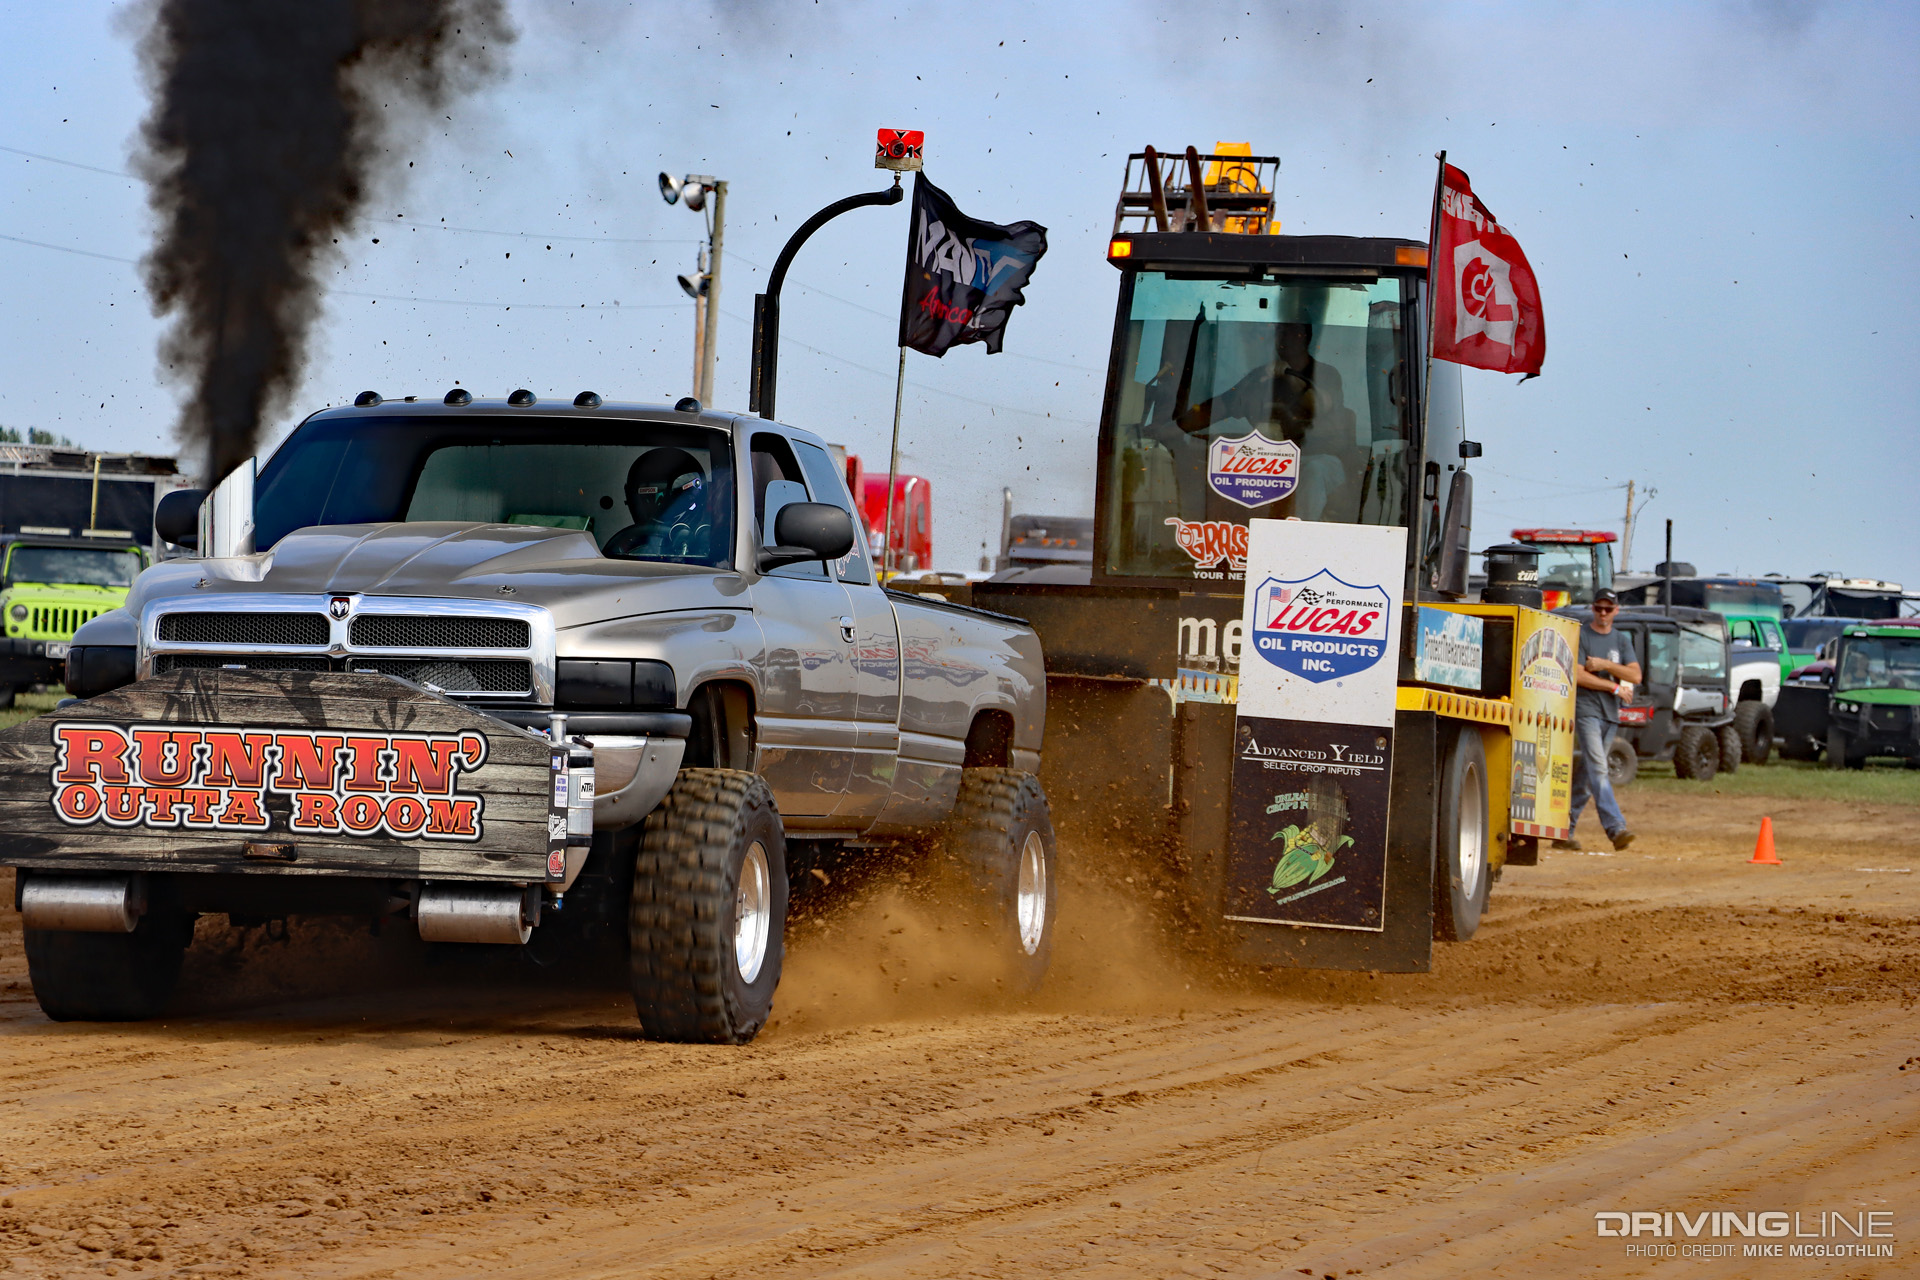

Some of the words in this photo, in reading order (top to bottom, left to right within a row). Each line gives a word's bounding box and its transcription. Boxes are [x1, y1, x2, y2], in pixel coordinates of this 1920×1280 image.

[1220, 456, 1292, 475] LUCAS
[1214, 477, 1232, 486] OIL
[1235, 478, 1292, 488] PRODUCTS
[1242, 490, 1263, 498] INC.
[1193, 571, 1224, 579] YOUR
[1326, 599, 1384, 608] PERFORMANCE
[1267, 605, 1380, 635] LUCAS
[1259, 637, 1286, 651] OIL
[1291, 640, 1379, 658] PRODUCTS
[1302, 658, 1335, 672] INC.
[58, 729, 482, 794] RUNNIN'
[1329, 743, 1384, 765] YIELD
[1263, 761, 1299, 771] SELECT
[1300, 764, 1326, 773] CROP
[1327, 766, 1361, 776] INPUTS
[59, 784, 266, 825] OUTTA
[295, 793, 477, 835] ROOM
